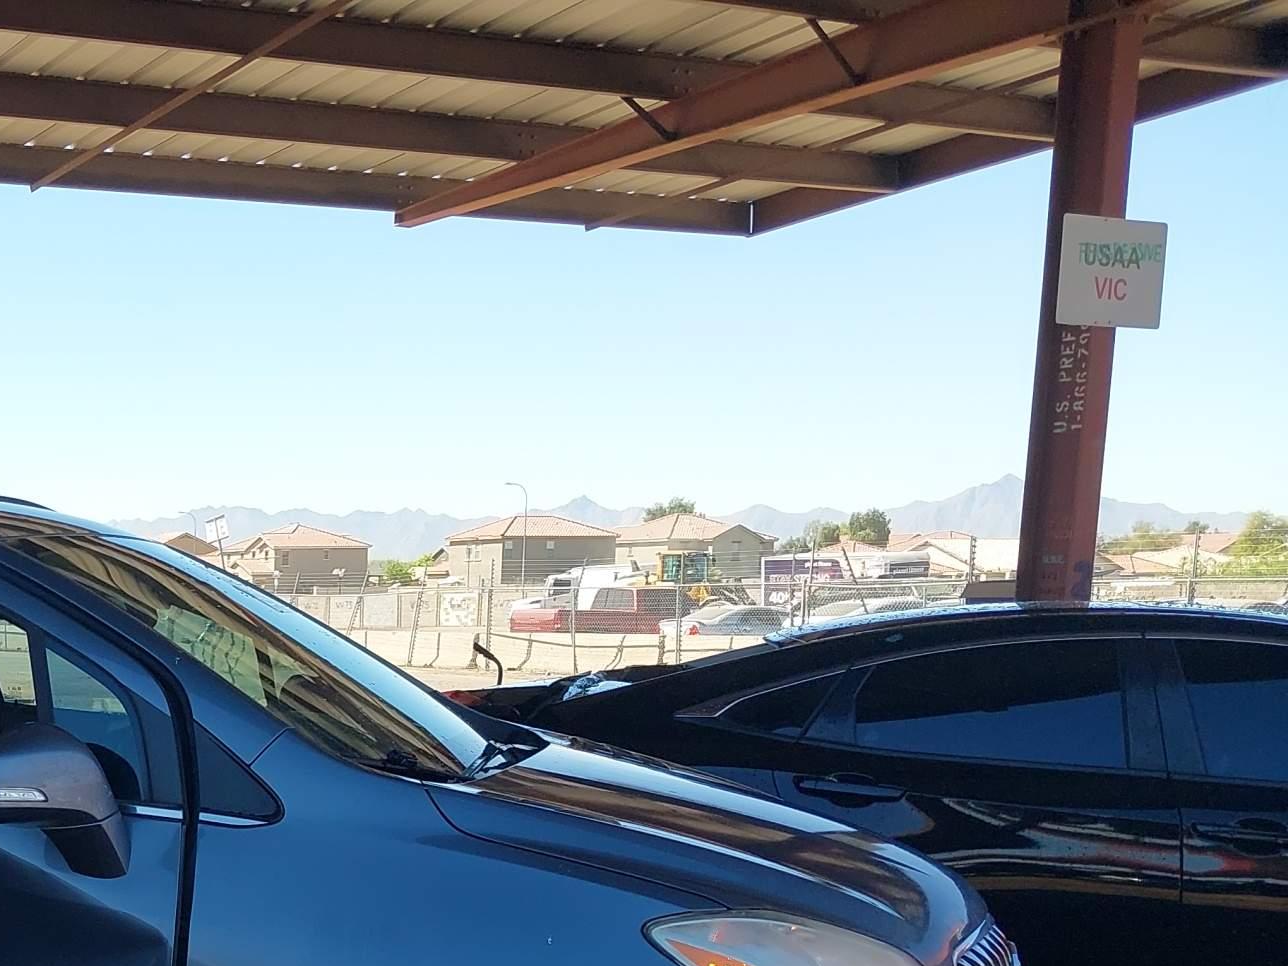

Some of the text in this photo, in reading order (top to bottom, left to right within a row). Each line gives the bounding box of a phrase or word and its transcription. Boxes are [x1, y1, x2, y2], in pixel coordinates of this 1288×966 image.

[1084, 244, 1140, 269] USAA
[1095, 276, 1127, 300] VIC
[1053, 394, 1070, 433] U.S.
